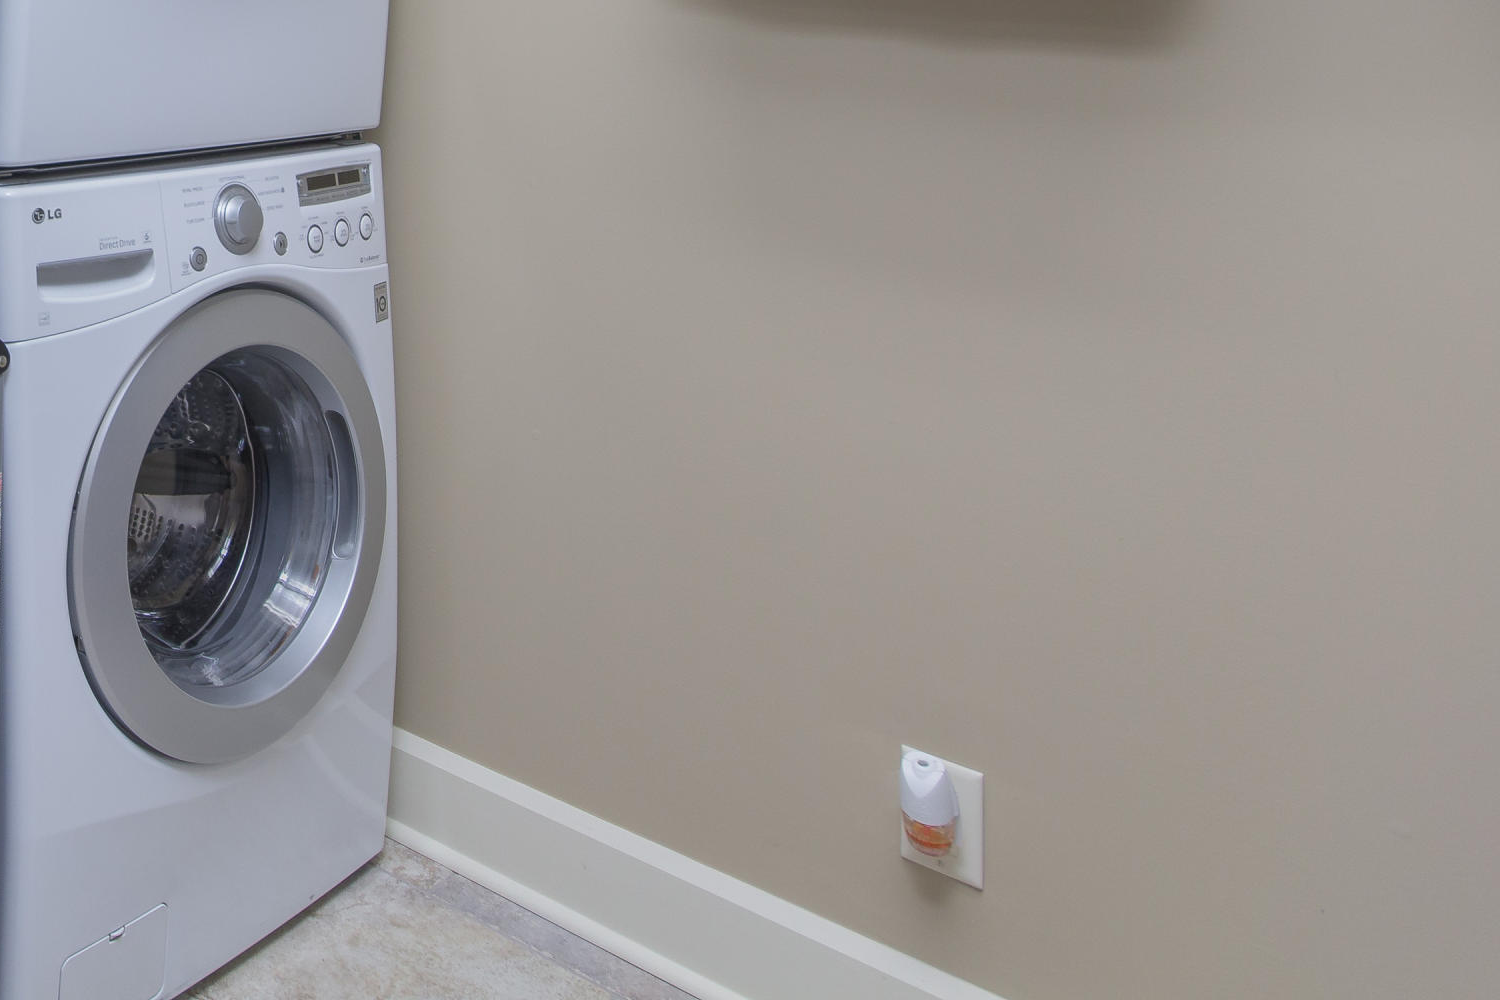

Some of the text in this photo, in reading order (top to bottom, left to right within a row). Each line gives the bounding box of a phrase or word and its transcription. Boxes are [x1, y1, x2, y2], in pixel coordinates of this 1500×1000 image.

[47, 208, 62, 220] LG
[99, 239, 136, 251] Direct Drive
